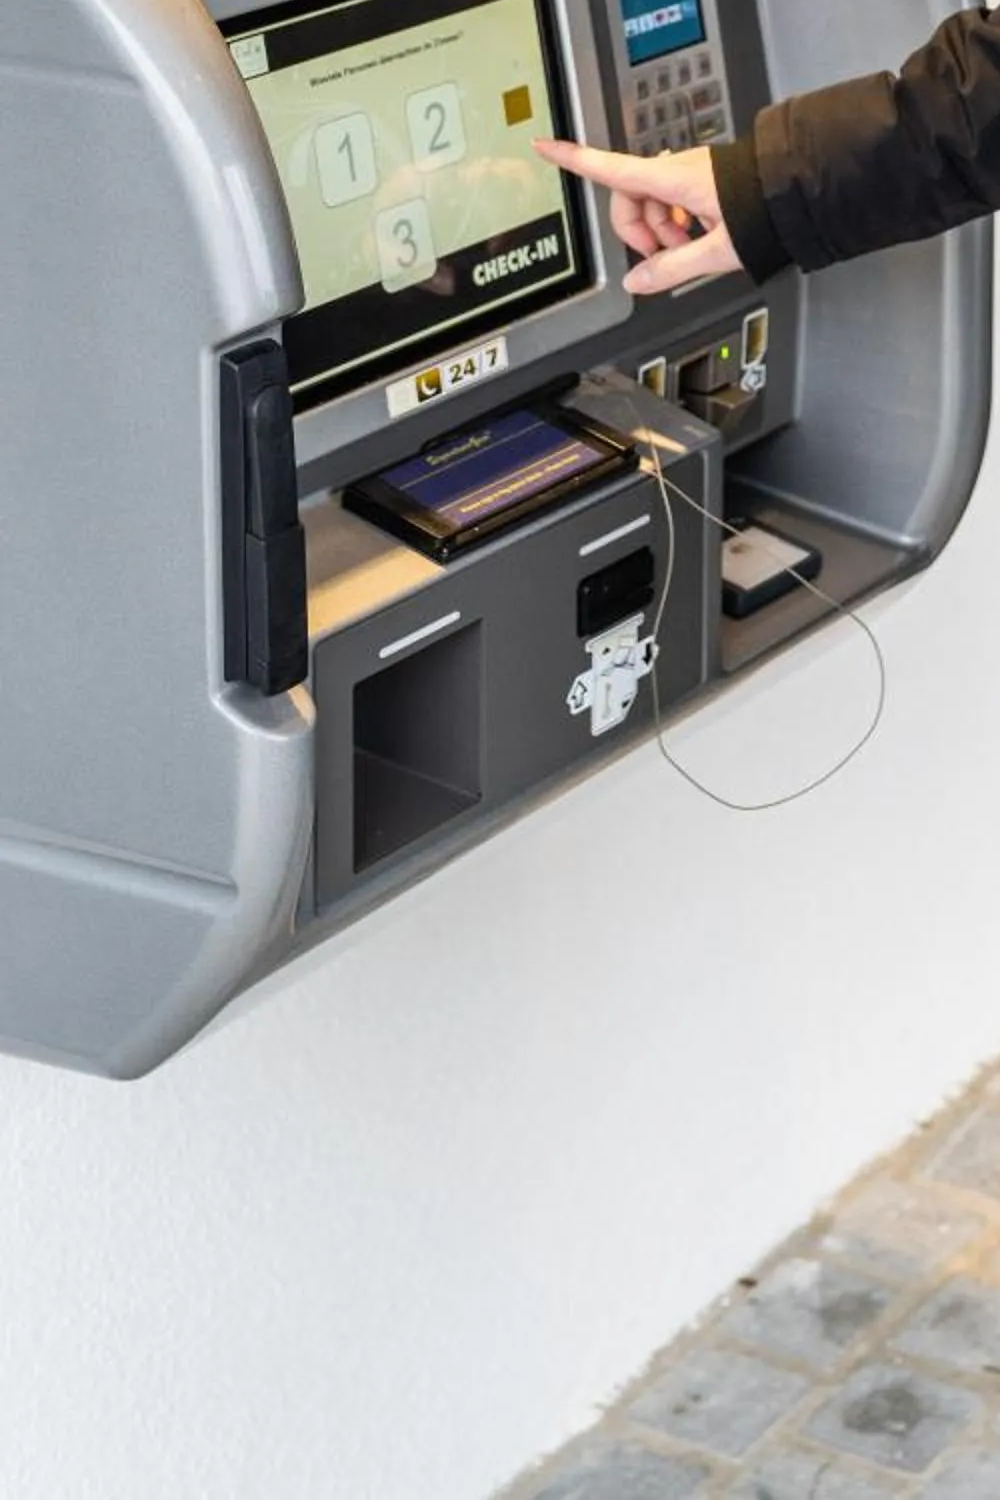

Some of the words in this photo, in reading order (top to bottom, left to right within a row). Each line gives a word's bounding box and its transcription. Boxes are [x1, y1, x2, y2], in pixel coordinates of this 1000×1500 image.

[424, 101, 452, 154] 2
[338, 131, 358, 182] 1
[393, 218, 418, 268] 3
[472, 234, 559, 287] CHECK-IN
